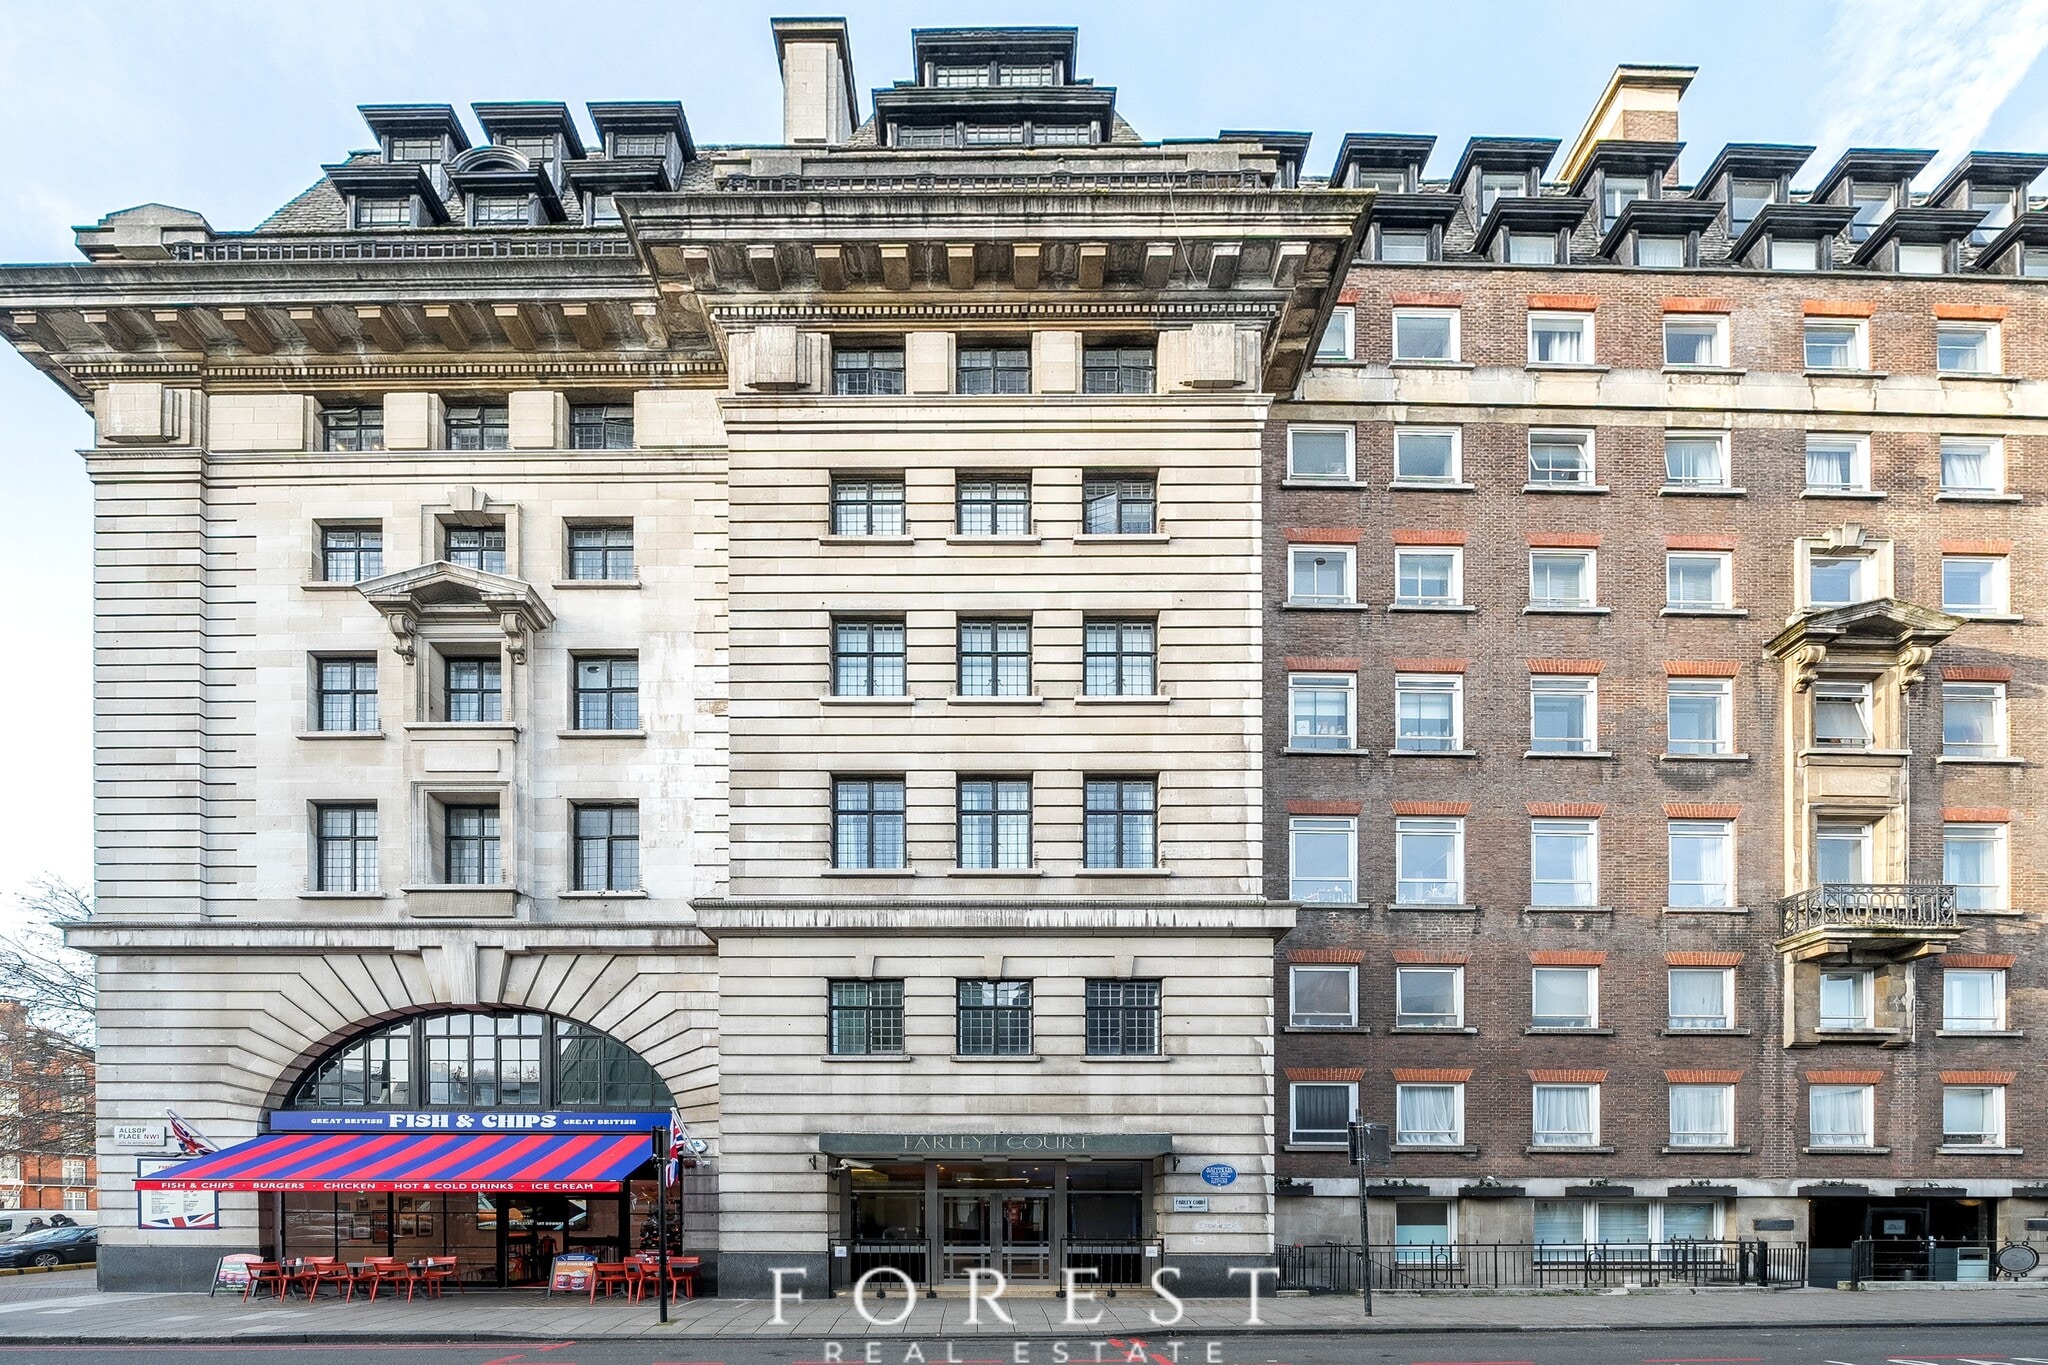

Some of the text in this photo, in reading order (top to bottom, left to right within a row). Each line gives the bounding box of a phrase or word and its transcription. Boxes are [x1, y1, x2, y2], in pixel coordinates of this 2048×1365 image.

[389, 1114, 450, 1128] FISH
[456, 1114, 475, 1128] &
[482, 1114, 557, 1128] CHIPS
[903, 1136, 1092, 1149] FARLEY COURT
